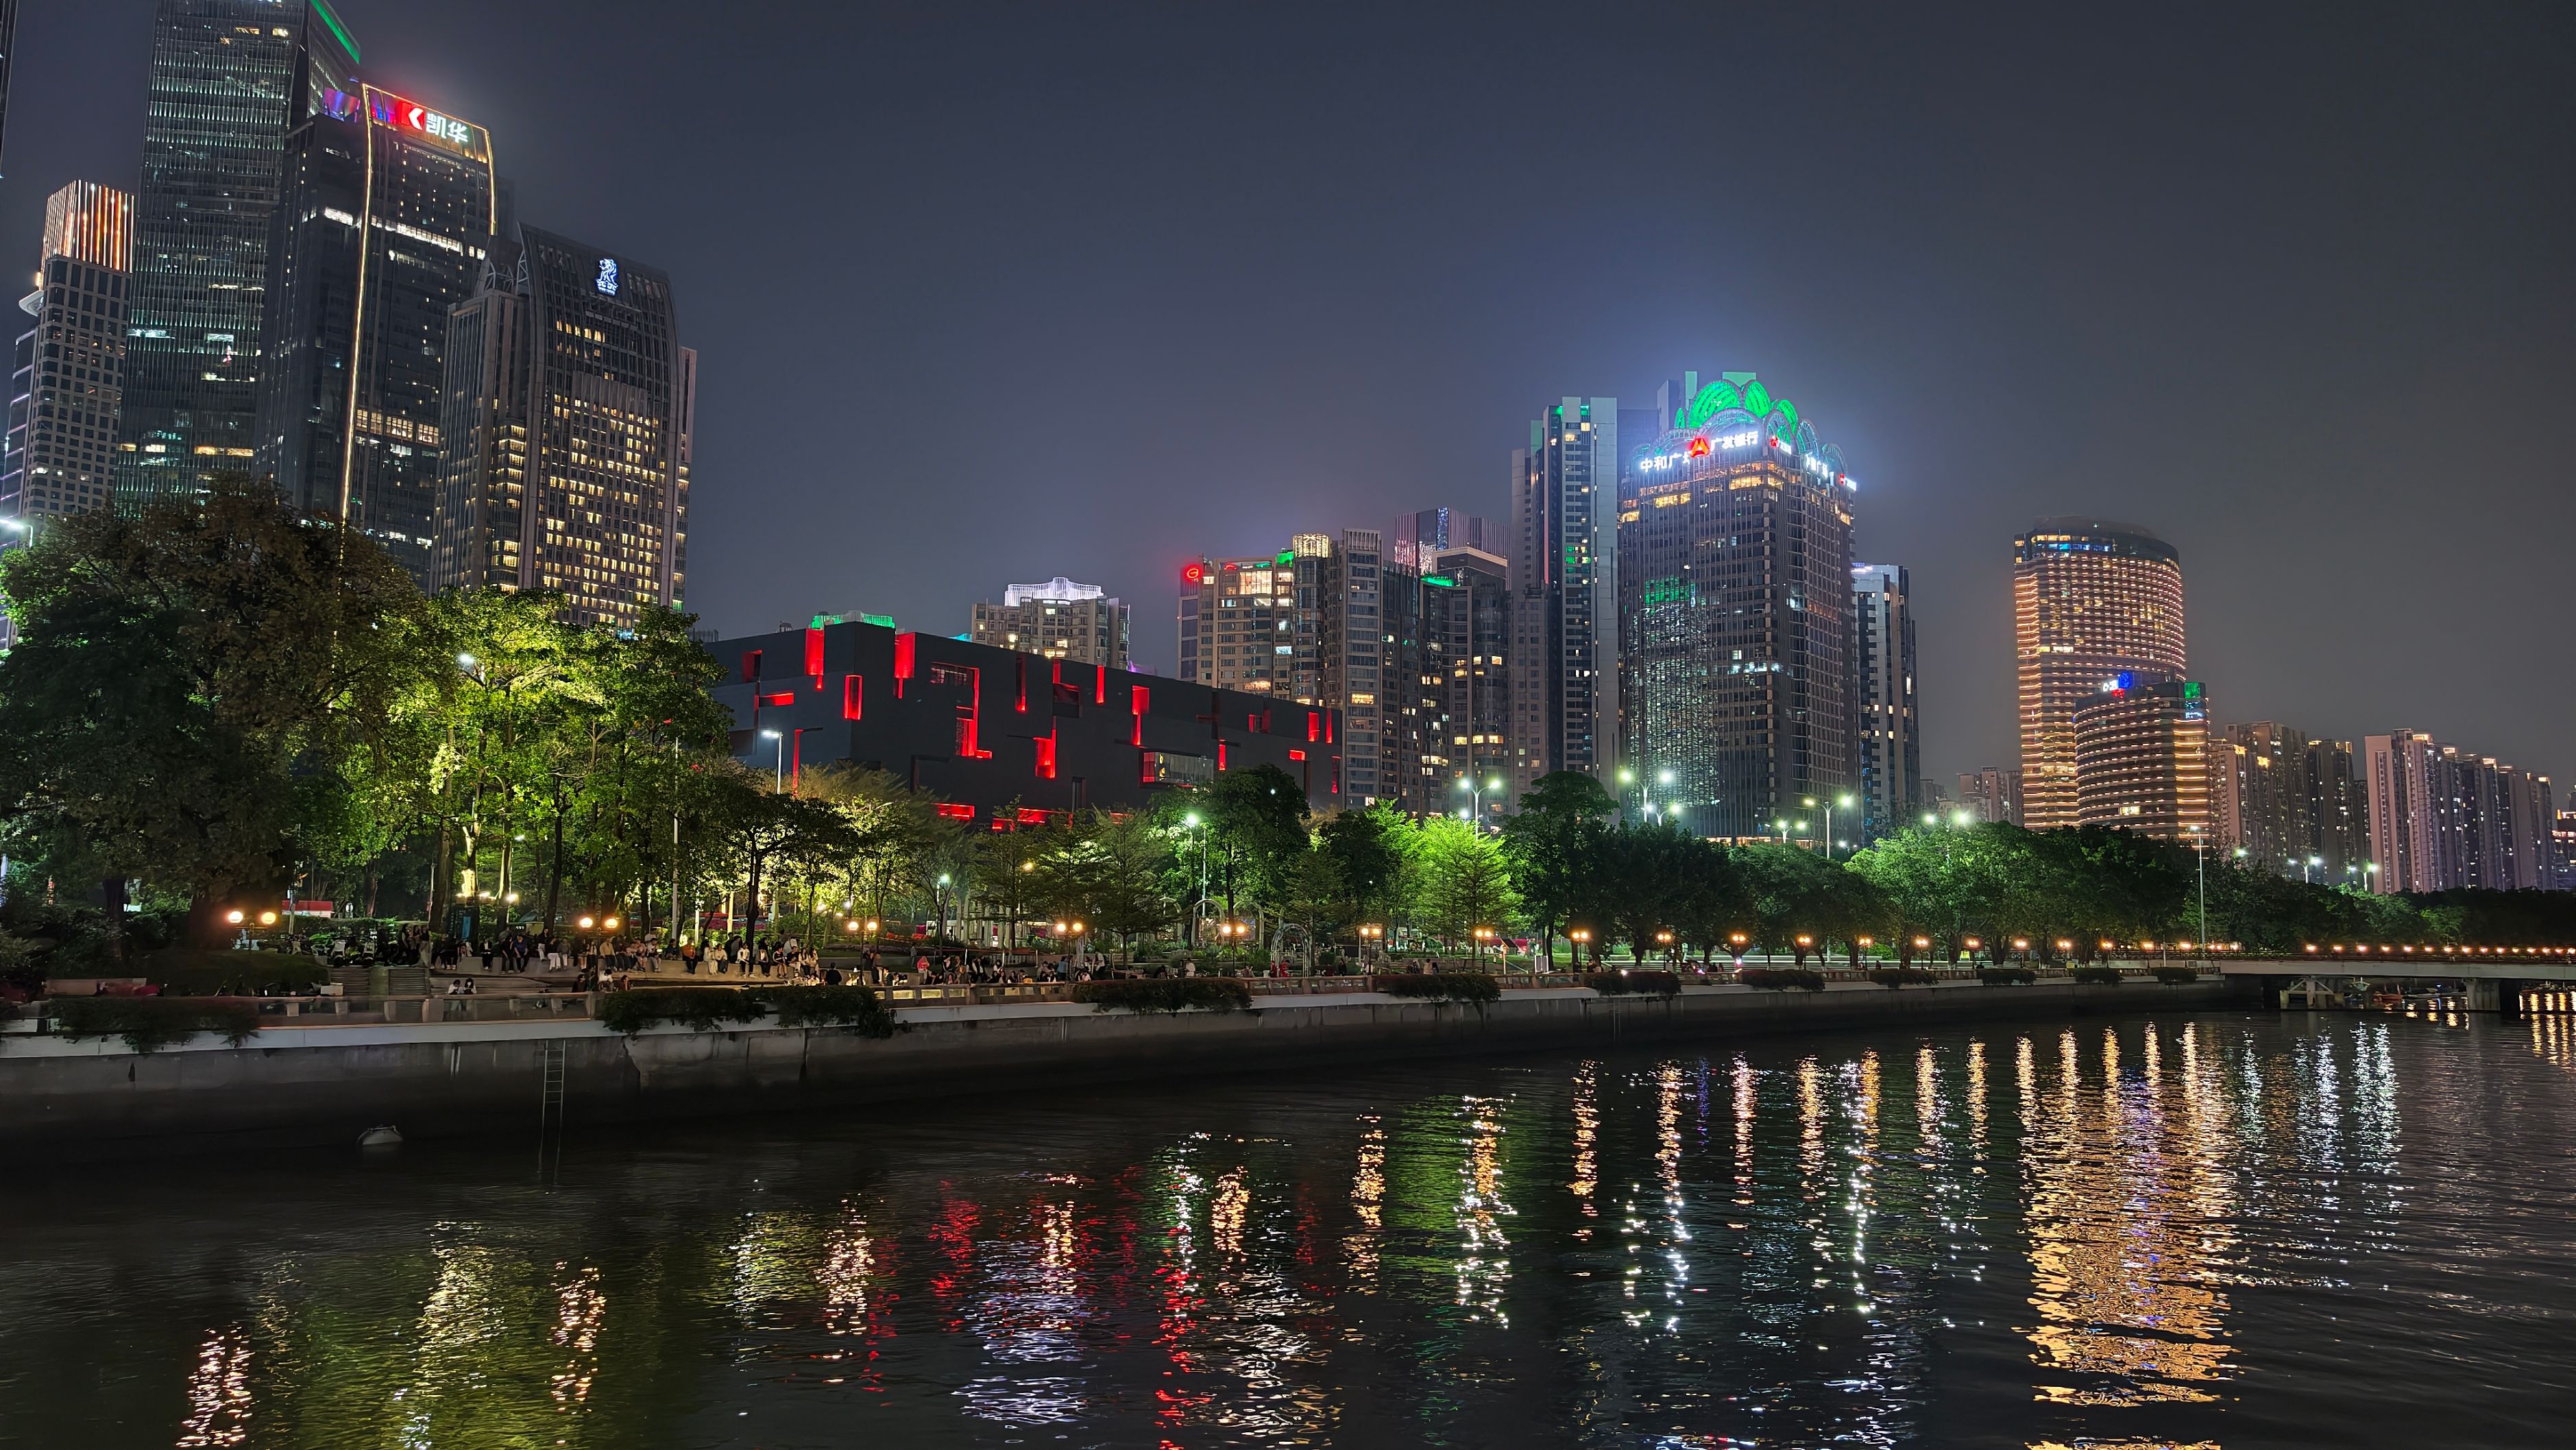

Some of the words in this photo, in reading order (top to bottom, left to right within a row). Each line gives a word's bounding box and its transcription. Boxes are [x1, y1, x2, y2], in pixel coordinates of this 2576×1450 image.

[426, 112, 468, 143] 凯华
[1710, 431, 1758, 452] 广发银行
